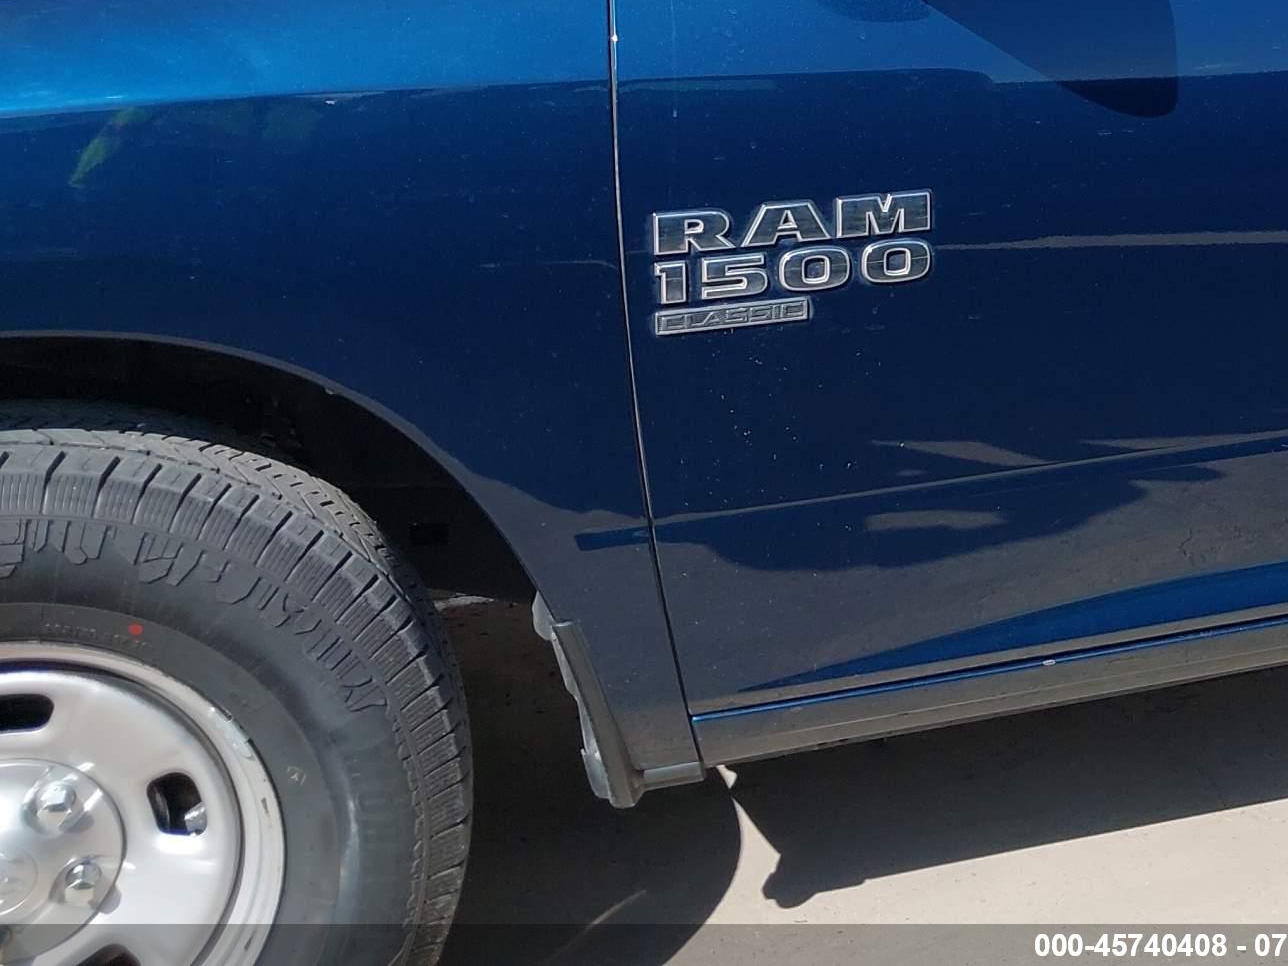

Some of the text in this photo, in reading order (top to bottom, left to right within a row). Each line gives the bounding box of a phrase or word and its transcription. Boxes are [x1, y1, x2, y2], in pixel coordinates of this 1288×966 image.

[652, 189, 932, 256] RAM
[653, 239, 931, 304] 1500
[658, 299, 808, 332] CLASSIC
